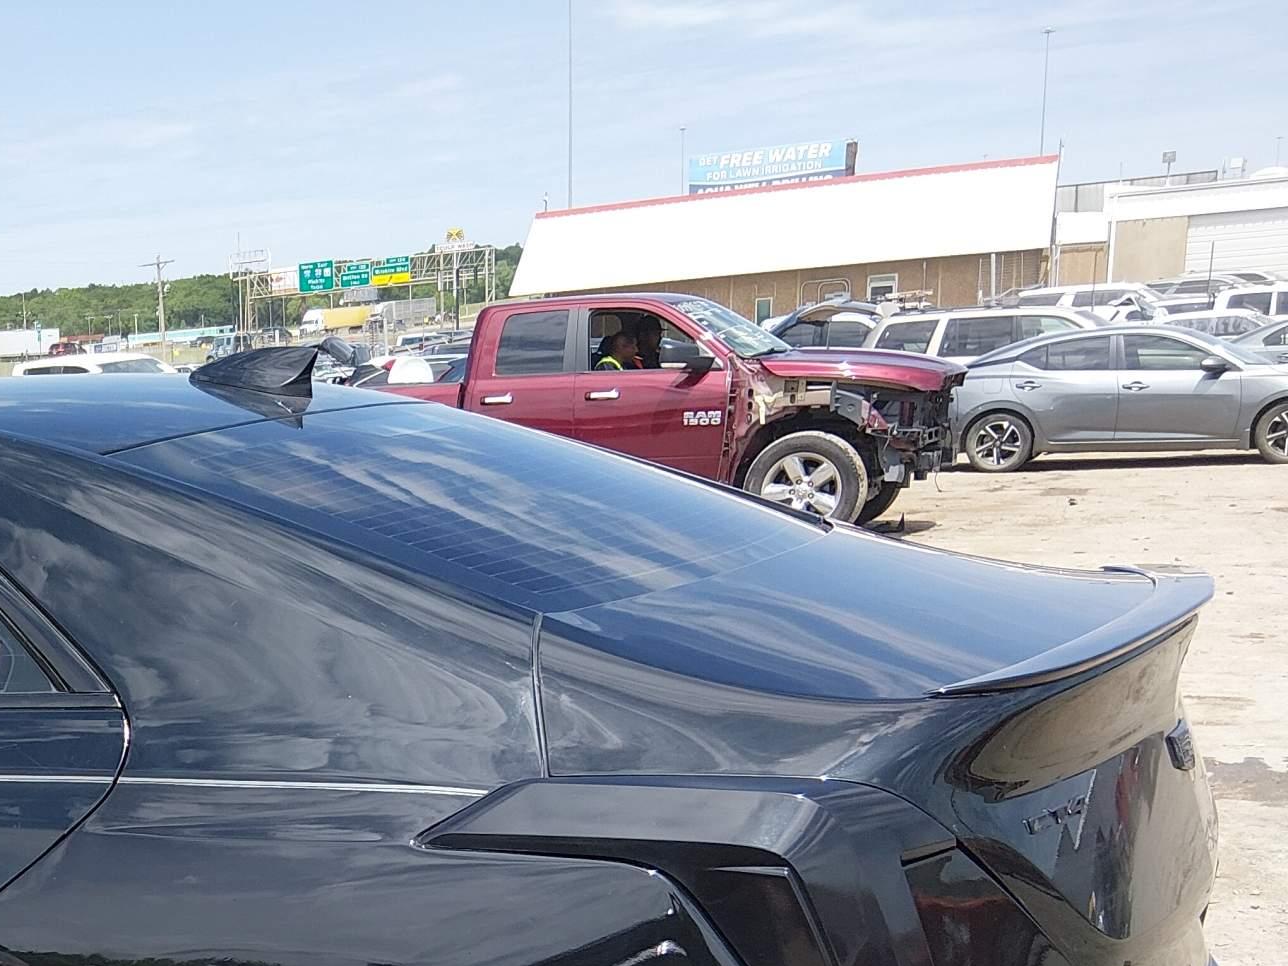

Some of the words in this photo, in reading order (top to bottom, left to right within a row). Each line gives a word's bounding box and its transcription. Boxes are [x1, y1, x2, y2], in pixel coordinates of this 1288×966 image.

[719, 150, 763, 169] FREE
[768, 143, 832, 163] WATER
[706, 170, 727, 181] FOR
[729, 166, 760, 179] LAWN
[761, 159, 823, 177] IRRIGATION
[683, 410, 722, 418] RAM
[683, 418, 722, 426] 1500
